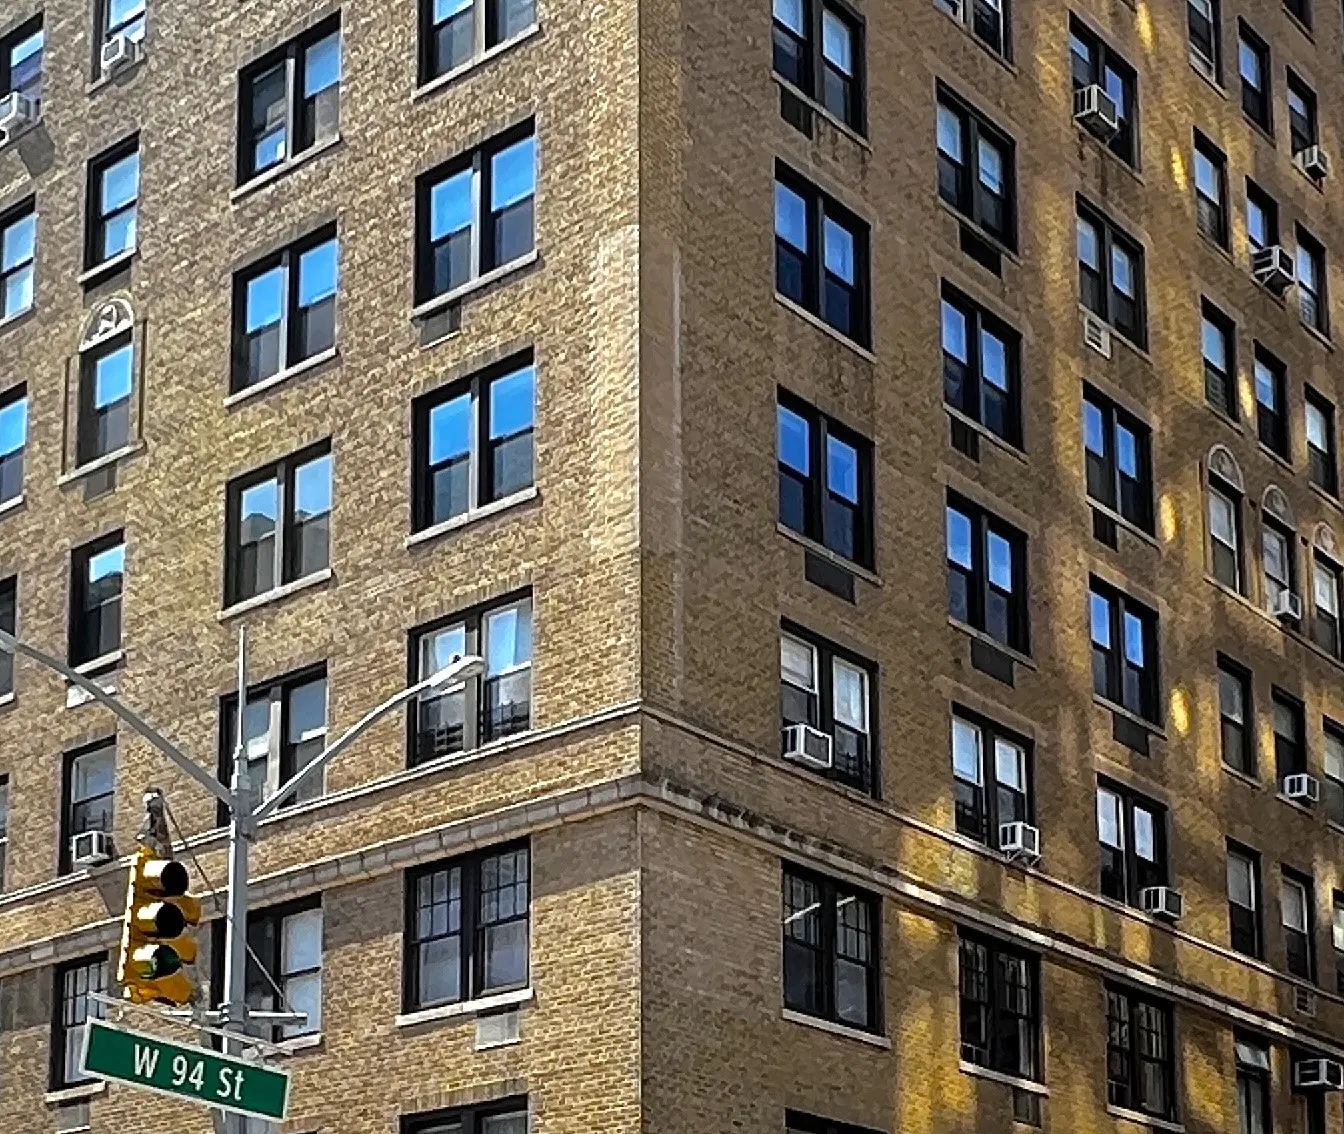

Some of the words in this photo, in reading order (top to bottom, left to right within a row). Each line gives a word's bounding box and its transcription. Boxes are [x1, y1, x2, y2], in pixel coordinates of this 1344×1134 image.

[134, 1043, 160, 1078] W
[171, 1055, 205, 1091] 94
[216, 1066, 245, 1100] St
